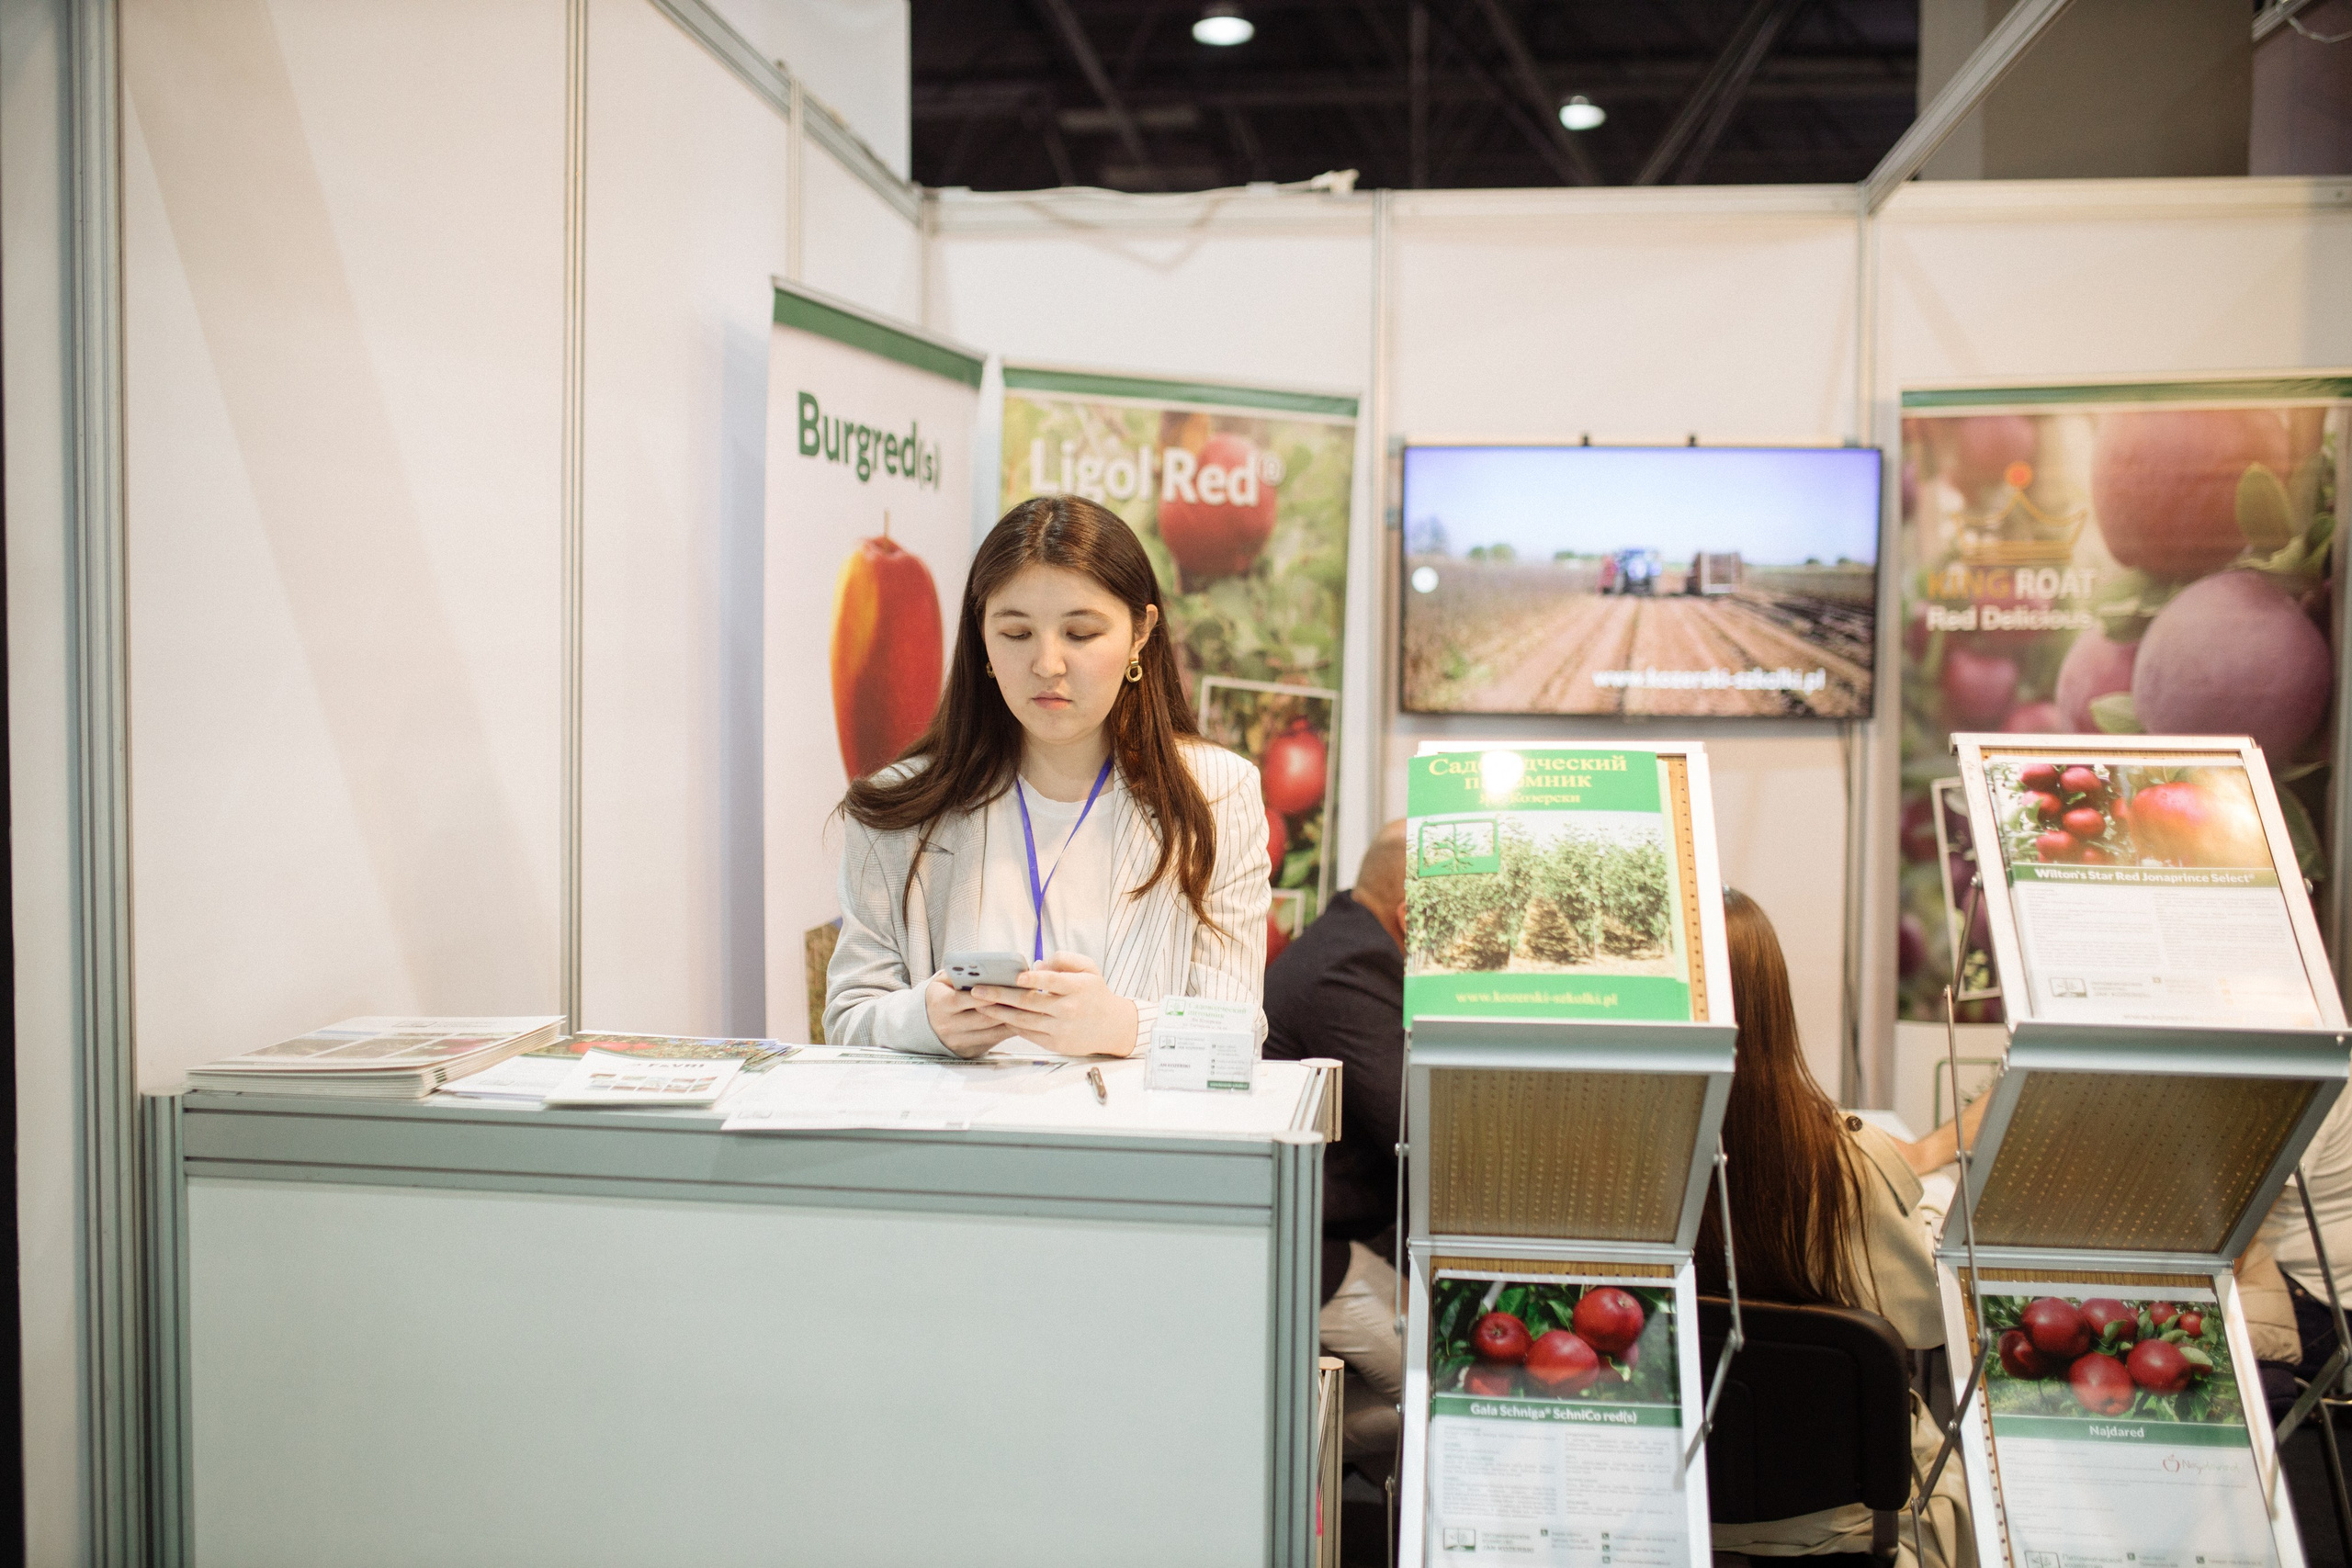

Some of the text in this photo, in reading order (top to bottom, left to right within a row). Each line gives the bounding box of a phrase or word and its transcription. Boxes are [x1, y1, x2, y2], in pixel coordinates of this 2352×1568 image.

[797, 390, 943, 491] Burgred(s)
[1029, 438, 1153, 502] Ligol
[1929, 567, 2096, 601] KING ROAT
[1928, 604, 2094, 632] Red Delicious
[1429, 754, 1628, 776] Саддческий
[2033, 868, 2087, 880] Wilton's
[2088, 871, 2113, 881] Star
[2115, 872, 2140, 882] Red
[2142, 872, 2210, 884] Jonaprince
[1470, 1403, 1498, 1416] Gala
[1553, 1408, 1601, 1422] SchniCo
[1603, 1411, 1638, 1425] red(s)
[2088, 1425, 2145, 1438] Najdared
